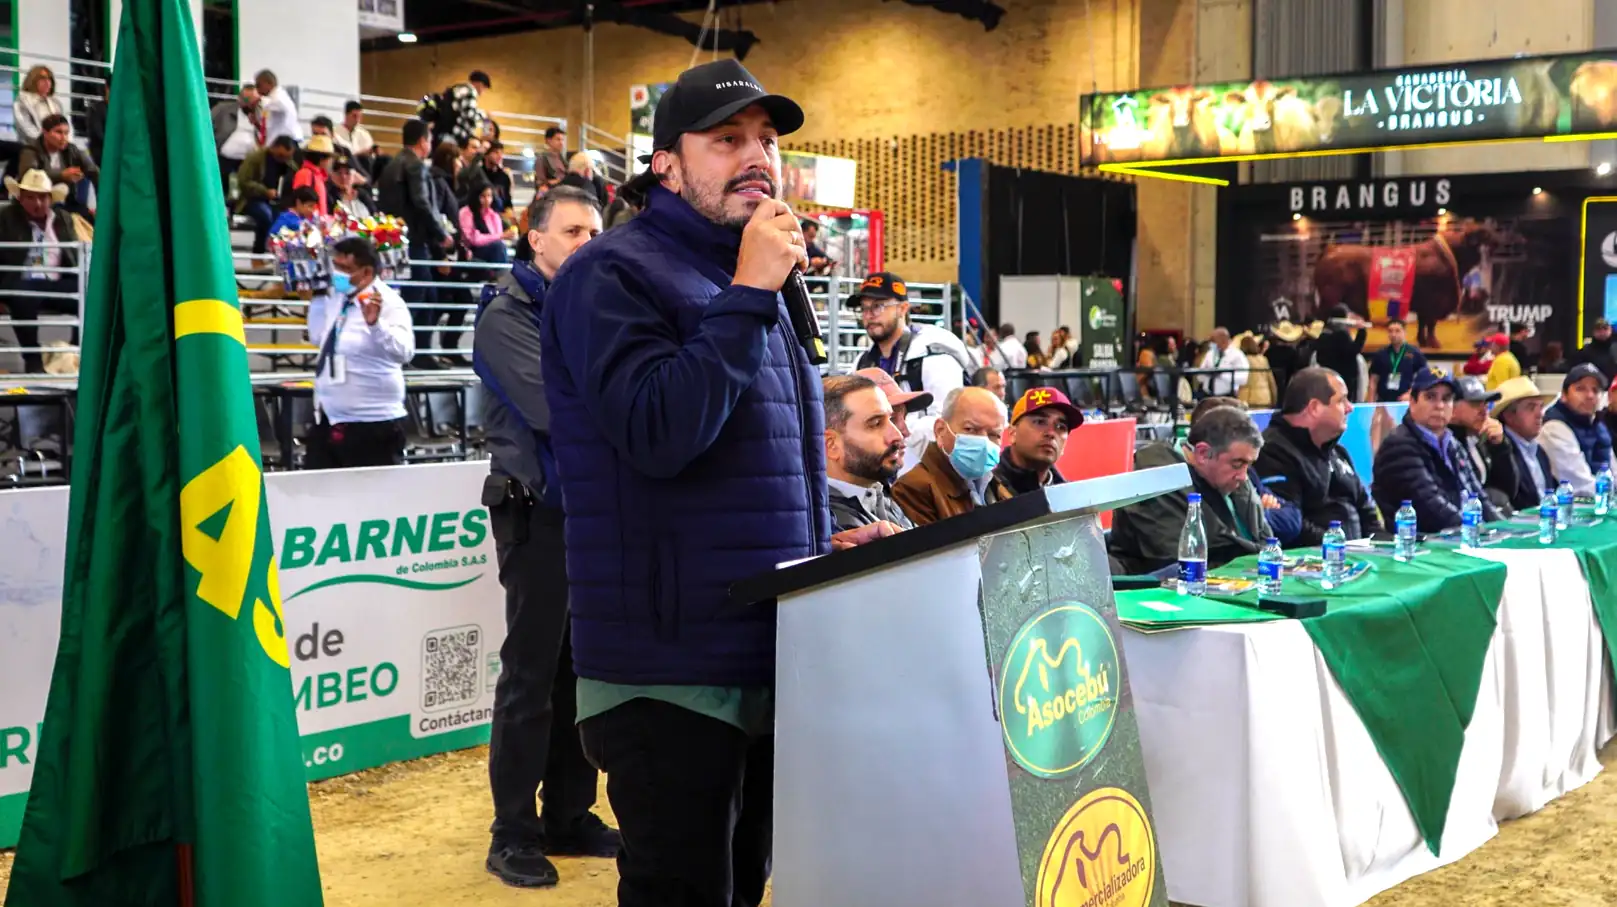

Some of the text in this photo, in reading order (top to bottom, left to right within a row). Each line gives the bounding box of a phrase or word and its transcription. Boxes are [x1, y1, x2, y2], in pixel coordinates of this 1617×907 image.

[1343, 76, 1522, 119] LA VICTORIA
[1290, 178, 1451, 211] BRANGUS
[1486, 304, 1553, 322] TRUMP
[279, 508, 488, 570] BARNES
[396, 565, 409, 575] de
[412, 559, 458, 572] Colombia
[294, 622, 344, 661] de
[1027, 661, 1109, 736] Asocebú
[302, 742, 344, 768] .co
